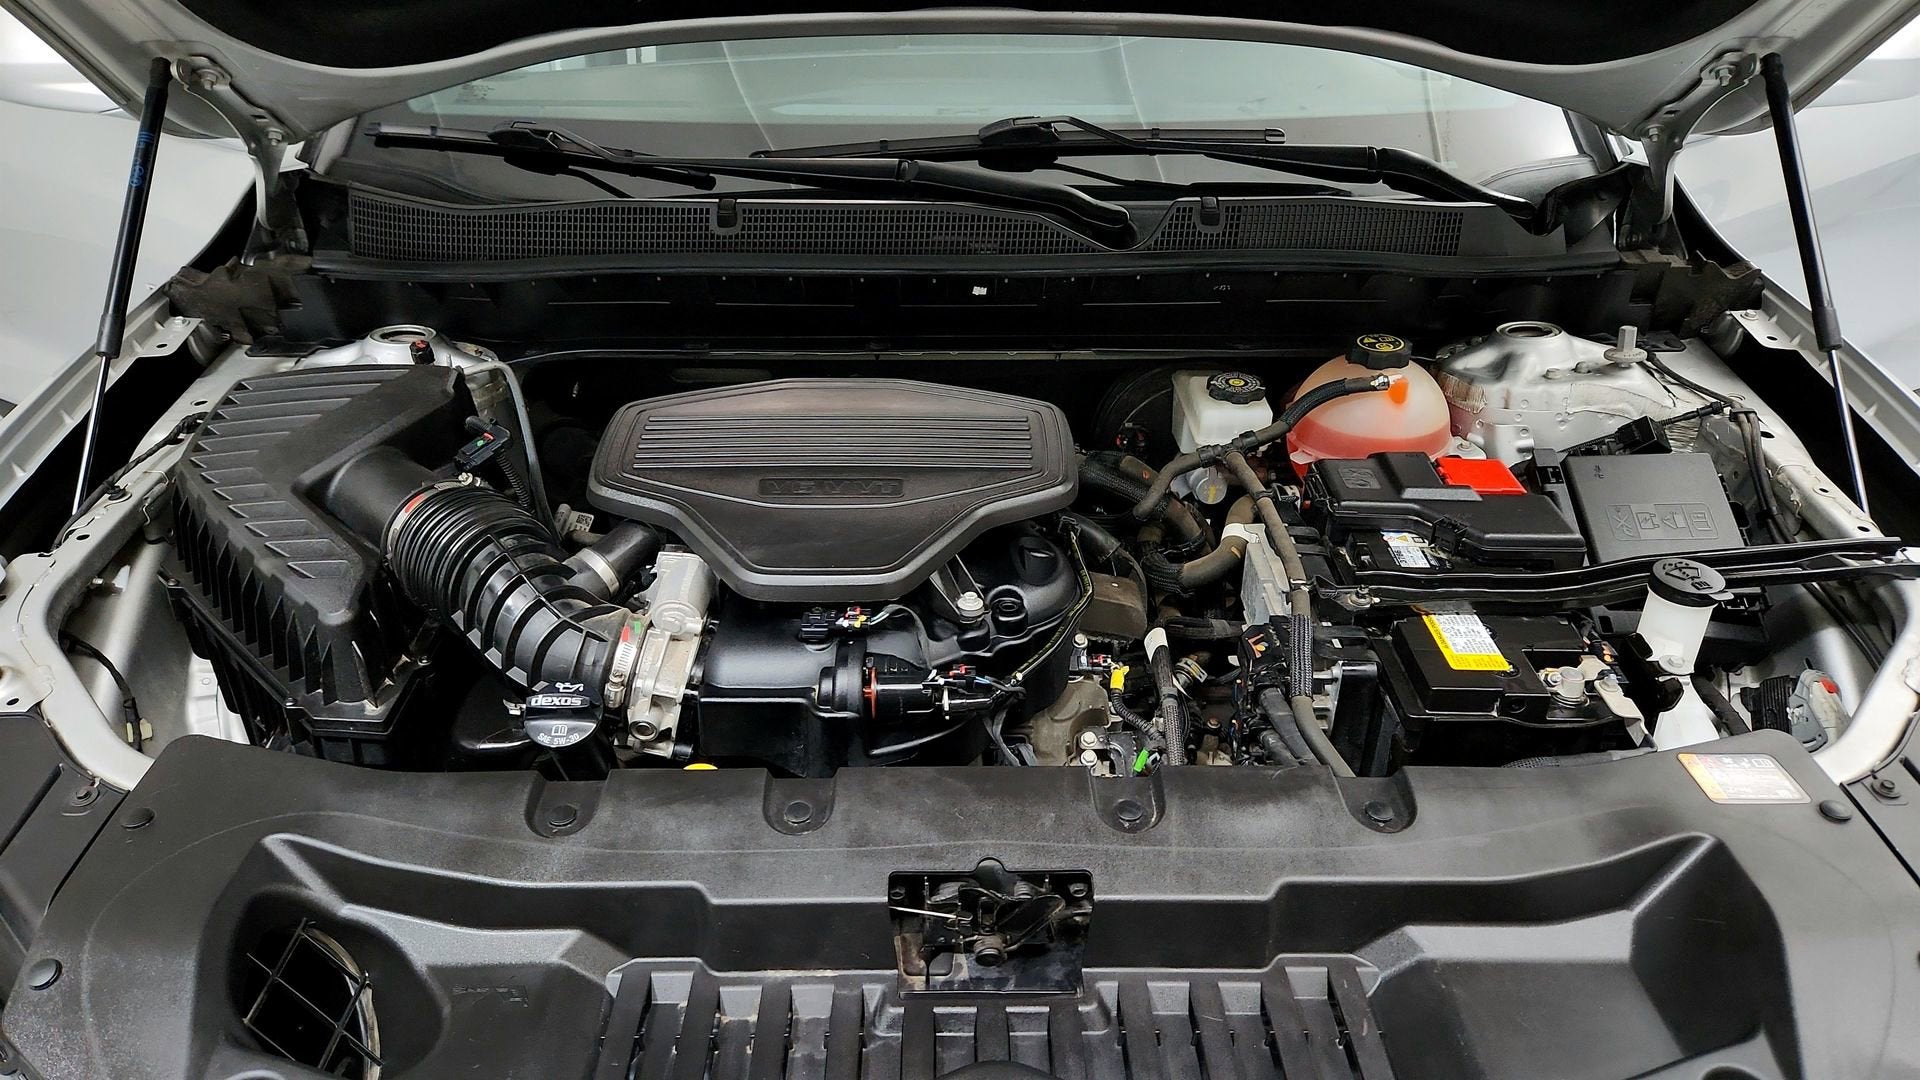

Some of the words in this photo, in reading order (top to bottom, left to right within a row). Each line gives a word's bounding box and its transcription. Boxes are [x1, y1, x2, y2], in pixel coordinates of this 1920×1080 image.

[530, 694, 582, 706] dexos
[537, 732, 552, 744] SAE
[553, 732, 580, 745] 5W-30
